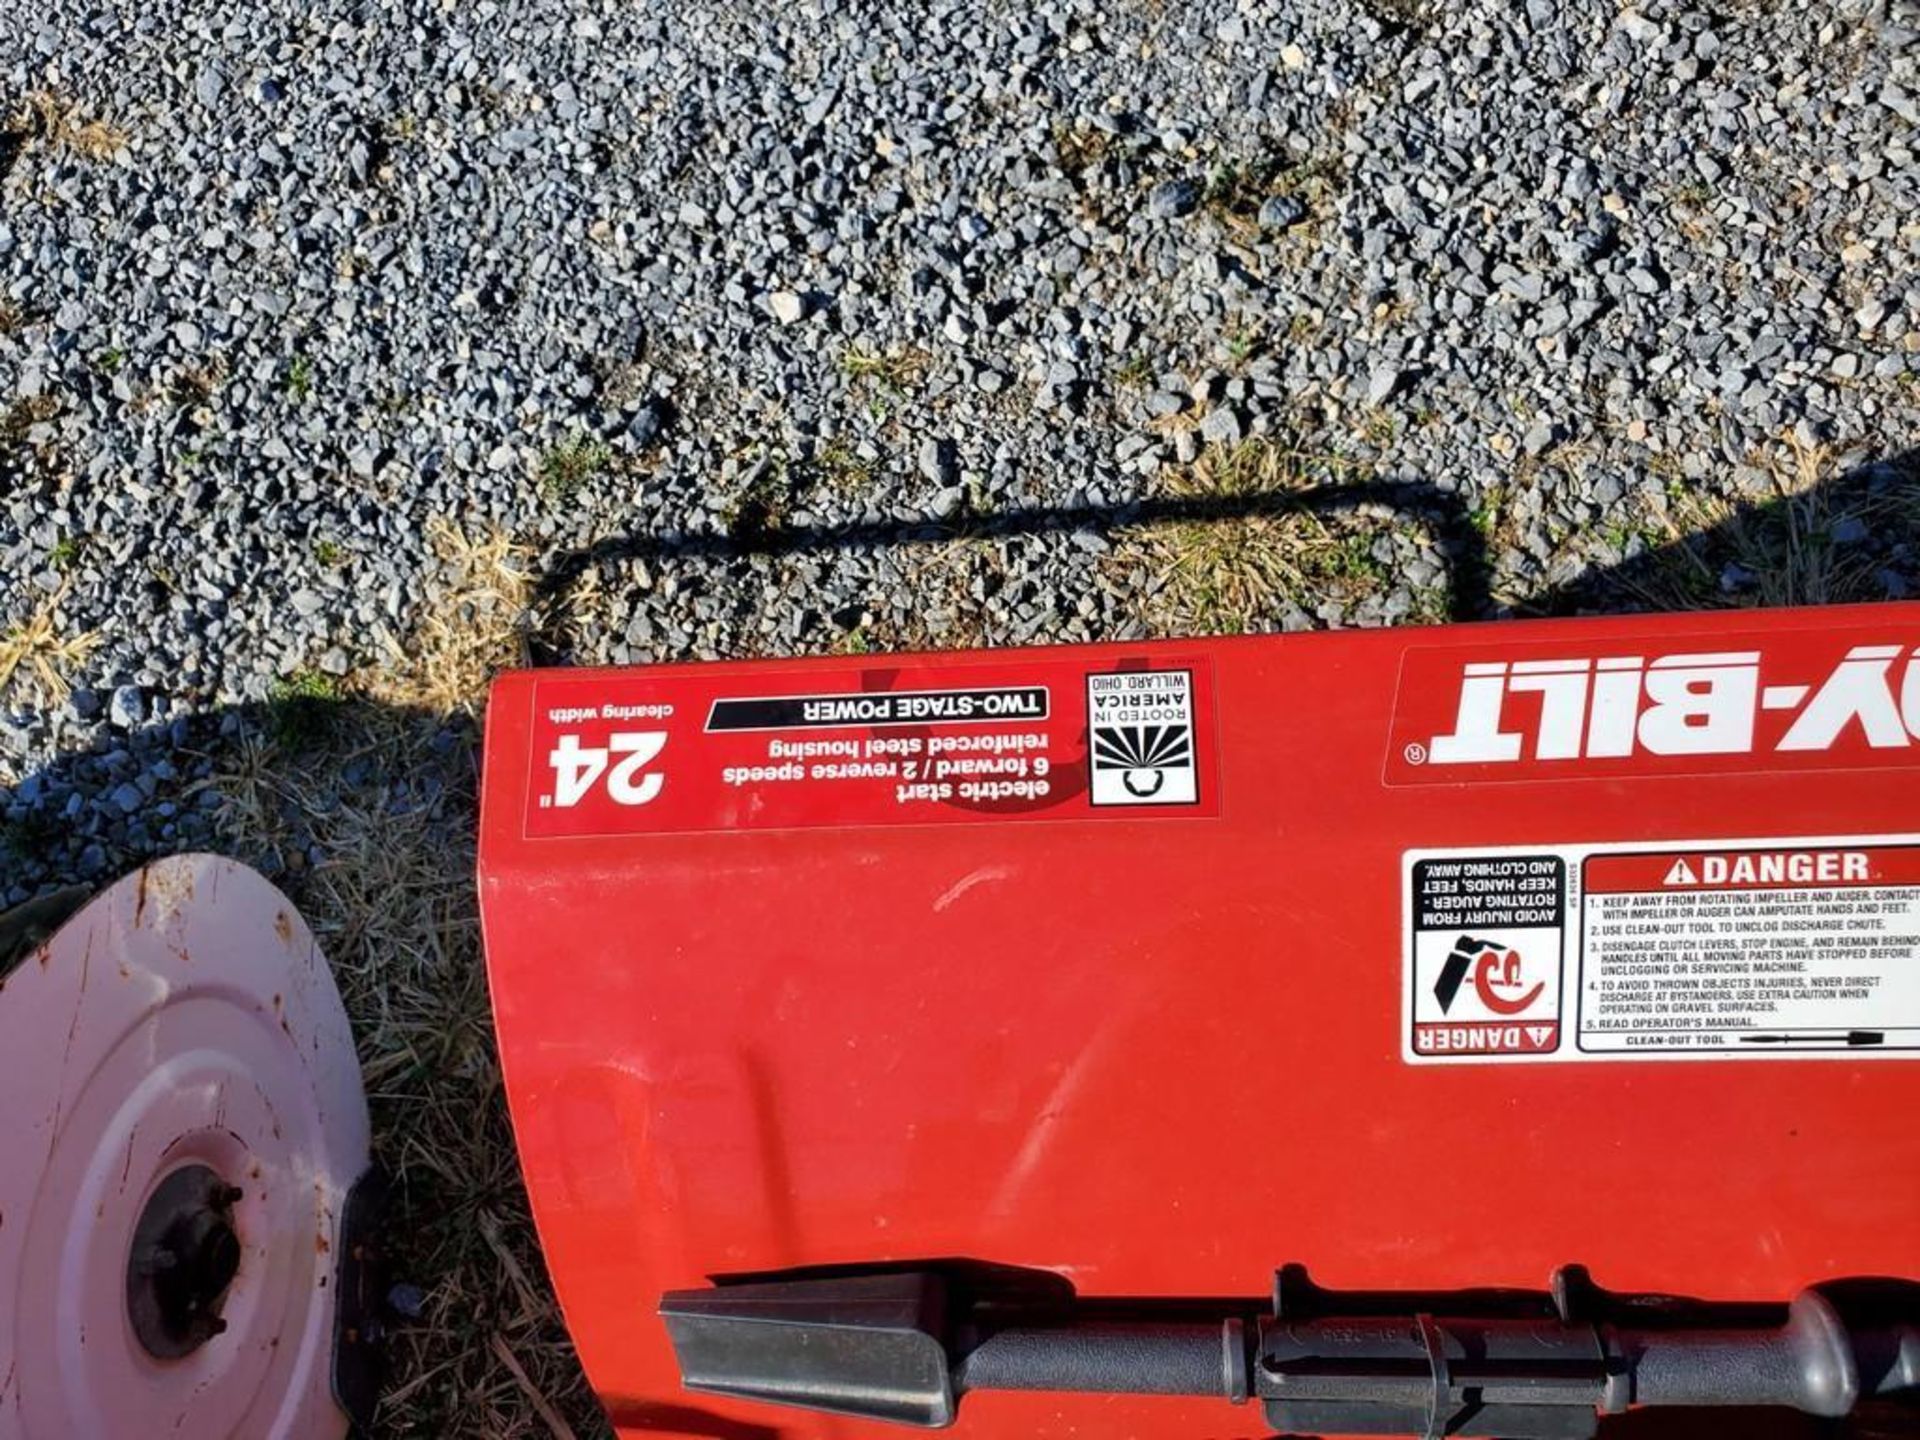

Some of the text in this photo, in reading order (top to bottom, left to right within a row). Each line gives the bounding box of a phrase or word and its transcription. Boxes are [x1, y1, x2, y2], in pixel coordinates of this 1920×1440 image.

[1092, 677, 1122, 690] OHIO
[803, 693, 1041, 720] TWO-STAGE POWER
[1094, 693, 1186, 708] AMERICA
[549, 704, 674, 724] clearing width
[1094, 708, 1186, 722] ROOTED IN
[769, 733, 1048, 760] reinforced steel housing
[811, 764, 897, 779] reverse
[902, 761, 917, 778] 2
[936, 758, 1031, 776] forward
[1034, 757, 1049, 775] 6
[723, 764, 804, 786] speeds
[896, 781, 1049, 802] electric start
[1424, 861, 1557, 877] AND CLOTHING AWAY.
[1702, 853, 1869, 884] DANGER
[1422, 877, 1557, 893] KEEP HANDS, FEET
[1432, 896, 1482, 909] AUGER
[1486, 894, 1557, 908] ROTATING
[1590, 899, 1599, 908] 1.
[1602, 897, 1630, 908] KEEP
[1632, 896, 1663, 907] AWAY
[1665, 895, 1697, 906] FROM
[1699, 894, 1751, 905] ROTATING
[1754, 892, 1809, 903] IMPELLER
[1811, 891, 1833, 902] AND
[1874, 889, 1920, 901] CONTACT
[1422, 910, 1557, 925] AVOID INJURY FROM
[1602, 902, 1910, 920] WITH IMPELLER OR AUGER CAN AMPUTATE HANDS AND FEET.
[1590, 918, 1886, 936] 2. USE CLEAN-OUT TOOL TO UNCLOG DISCHARGE CHUTE.
[1602, 940, 1656, 951] DISENGAGE
[1658, 940, 1696, 950] CLUTCH
[1699, 939, 1739, 950] LEVERS,
[1741, 938, 1768, 949] STOP
[1769, 937, 1809, 948] ENGINE,
[1812, 937, 1834, 947] AND
[1837, 936, 1878, 947] REMAIN
[1601, 947, 1913, 963] HANDLES UNTIL ALL MOVING PARTS HAVE STOPPED BEFORE
[1601, 961, 1809, 975] UNCLOGGING OR SERVICING MACHINE.
[1589, 981, 1598, 991] 4.
[1600, 980, 1615, 990] TO
[1617, 979, 1650, 990] AVOID
[1653, 979, 1699, 989] THROWN
[1702, 978, 1751, 989] OBJECTS
[1810, 976, 1843, 987] NEVER
[1844, 976, 1882, 987] DIRECT
[1600, 991, 1653, 1002] DISCHARGE
[1655, 991, 1667, 1001] AT
[1735, 989, 1755, 1000] USE
[1758, 989, 1791, 1000] EXTRA
[1792, 988, 1837, 999] CAUTION
[1838, 988, 1870, 999] WHEN
[1599, 1001, 1778, 1014] OPERATING ON GRAVEL SURFACES.
[1598, 1018, 1628, 1028] READ
[1632, 1017, 1702, 1028] OPERATOR'S
[1705, 1016, 1758, 1027] MANUAL.
[1418, 1027, 1520, 1049] DANGER
[1626, 1034, 1726, 1045] CLEAN-OUT TOOL
